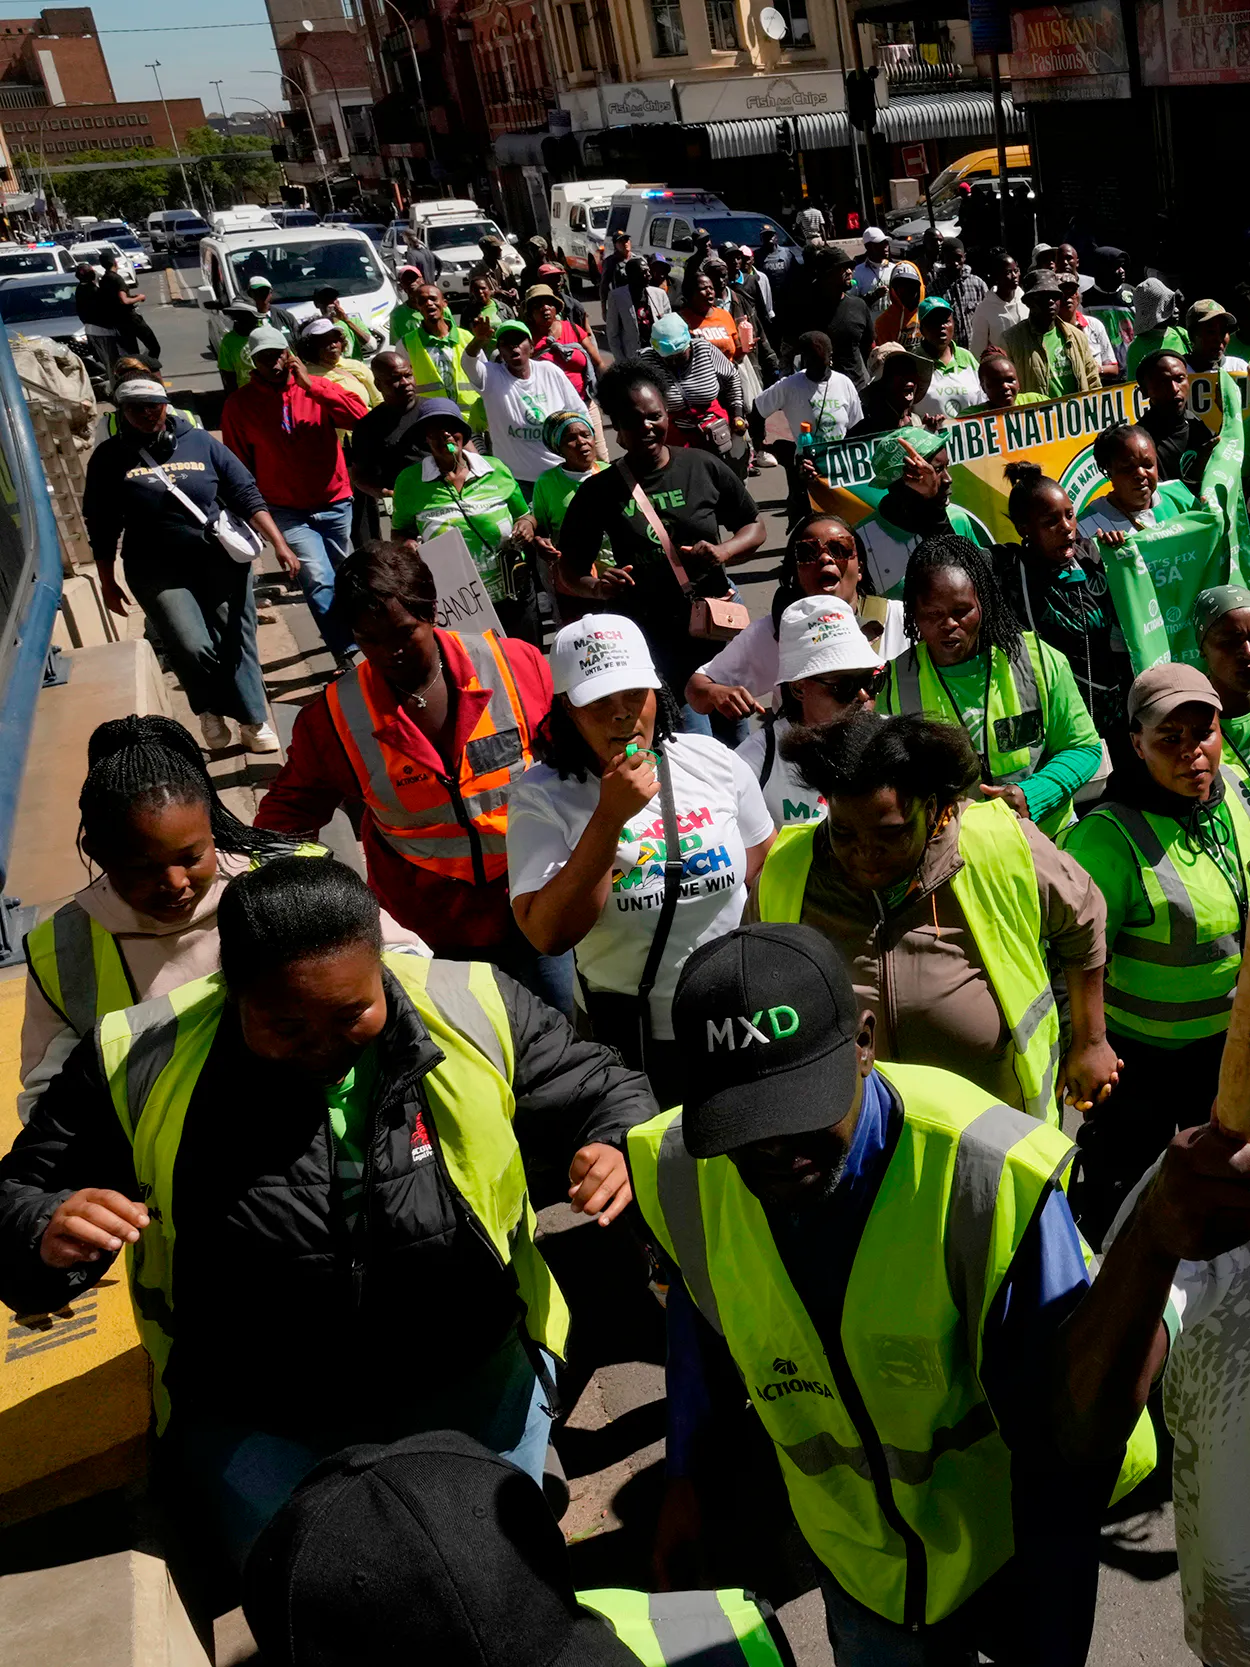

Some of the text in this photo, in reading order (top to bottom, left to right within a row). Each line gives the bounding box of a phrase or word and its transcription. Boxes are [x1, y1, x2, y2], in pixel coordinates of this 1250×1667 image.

[1026, 15, 1097, 50] MUSKAN
[1032, 50, 1082, 73] Fashions
[608, 103, 630, 115] Fish
[643, 99, 671, 113] Chips
[746, 95, 776, 109] Fish
[792, 92, 828, 107] Chips
[764, 261, 785, 271] POLICE
[936, 386, 969, 396] VOTE
[1003, 390, 1129, 453] NATIONAL
[126, 461, 206, 479] STRETSBORO
[1145, 523, 1185, 544] ACTIONSA
[1174, 550, 1197, 567] FIX
[1153, 565, 1184, 588] SA
[808, 613, 845, 630] MARCH
[819, 623, 841, 633] AND
[574, 631, 622, 650] MARCH
[587, 641, 616, 657] AND
[579, 649, 629, 670] MARCH
[585, 659, 628, 677] UNTIL WE WIN
[396, 773, 428, 788] ACTIONSA
[706, 872, 736, 893] WIN
[706, 1004, 800, 1053] MXD
[755, 1378, 835, 1402] ACTIONSA
